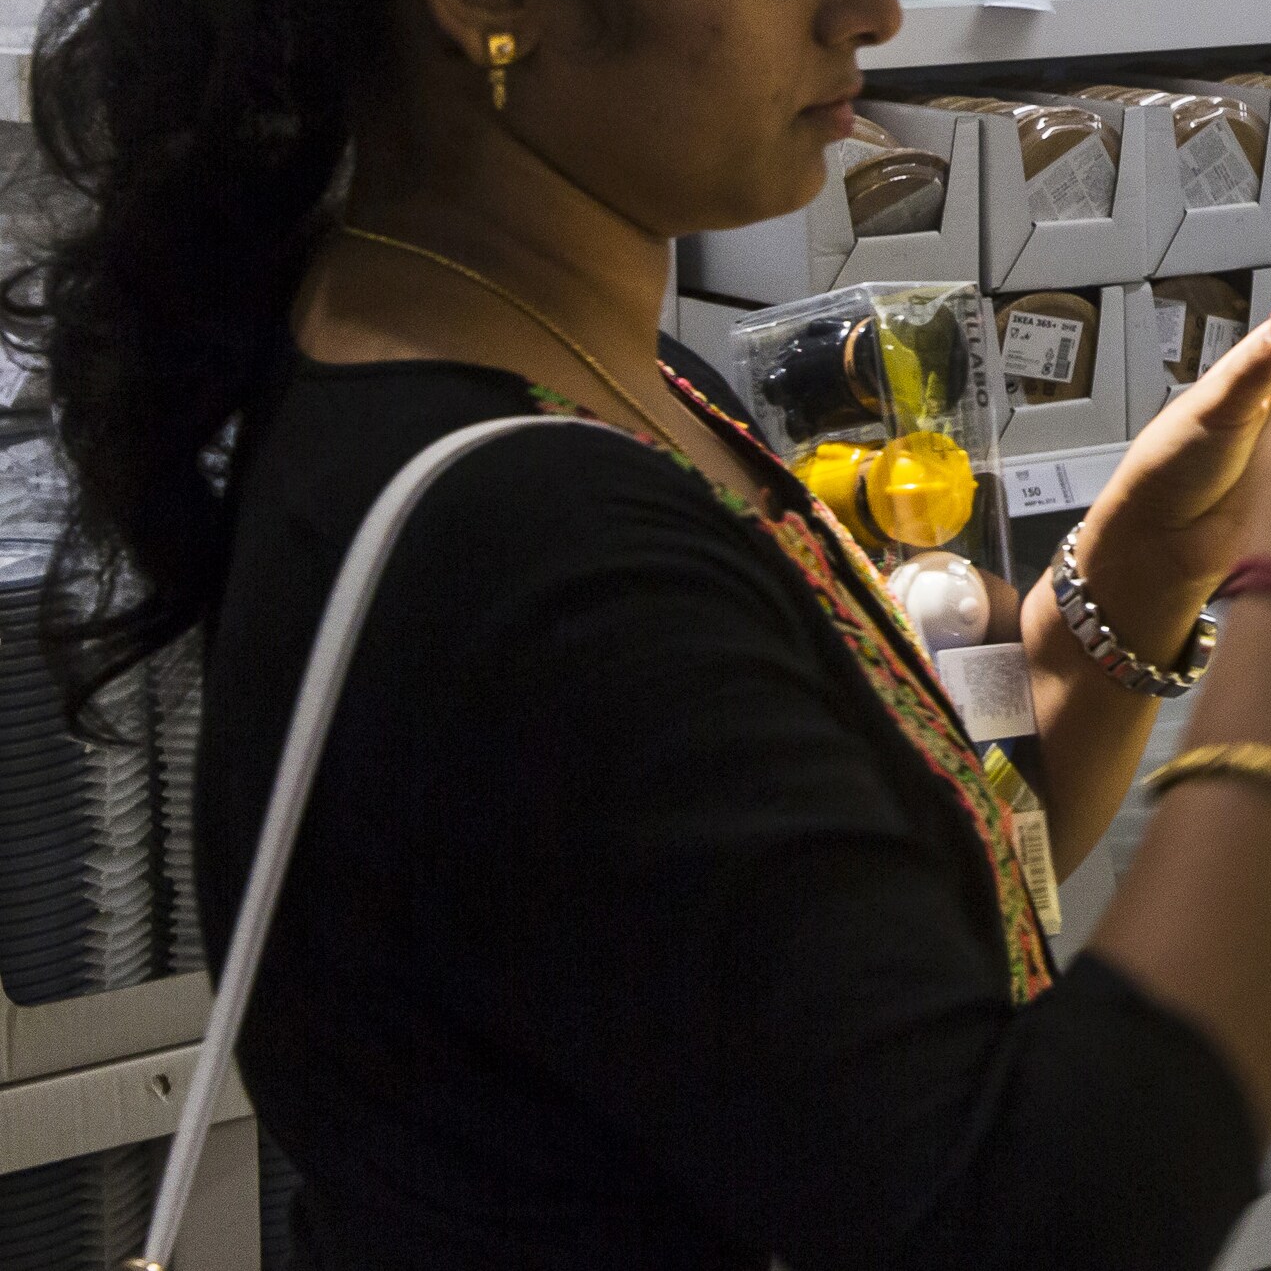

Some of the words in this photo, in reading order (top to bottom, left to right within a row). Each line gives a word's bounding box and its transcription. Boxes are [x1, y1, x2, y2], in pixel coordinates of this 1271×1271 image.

[1013, 314, 1034, 326] IKEA
[1036, 318, 1057, 329] 365+
[1022, 486, 1041, 498] 150
